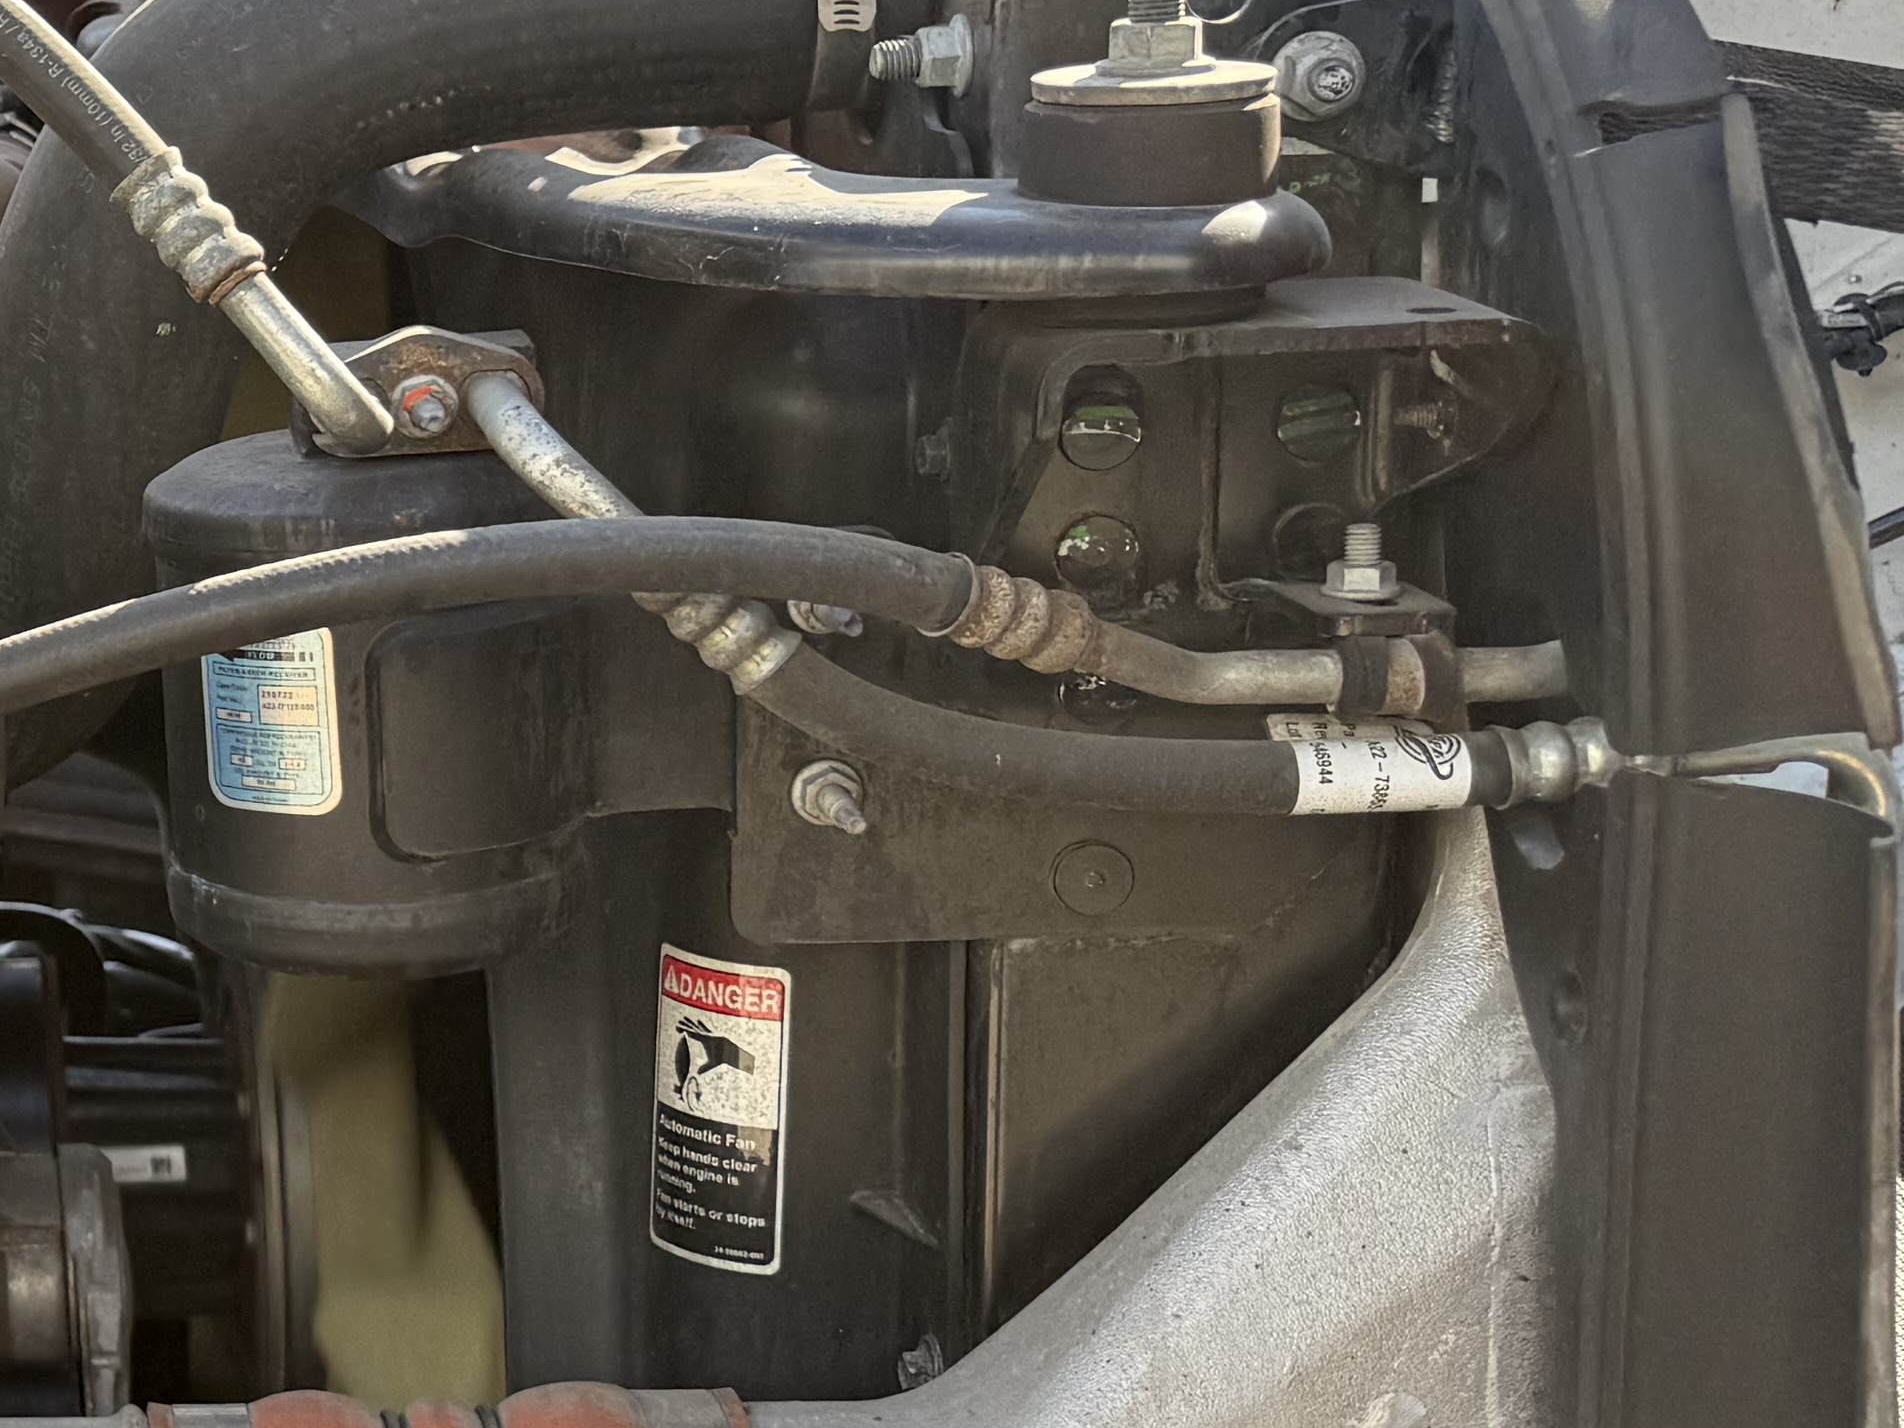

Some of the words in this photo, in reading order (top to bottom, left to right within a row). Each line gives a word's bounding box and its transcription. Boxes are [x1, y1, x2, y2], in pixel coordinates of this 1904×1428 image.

[17, 32, 65, 79] R-134a
[61, 80, 110, 128] (10mm)
[678, 976, 781, 1015] DANGER
[659, 1114, 722, 1145] Automatic
[725, 1133, 756, 1151] Fan
[658, 1136, 681, 1155] Keep
[682, 1145, 719, 1166] hands
[722, 1158, 758, 1172] clear
[658, 1154, 681, 1171] when
[682, 1162, 724, 1184] engine
[727, 1173, 740, 1186] is
[673, 1198, 706, 1217] starts
[708, 1209, 723, 1221] or
[726, 1212, 766, 1228] stops
